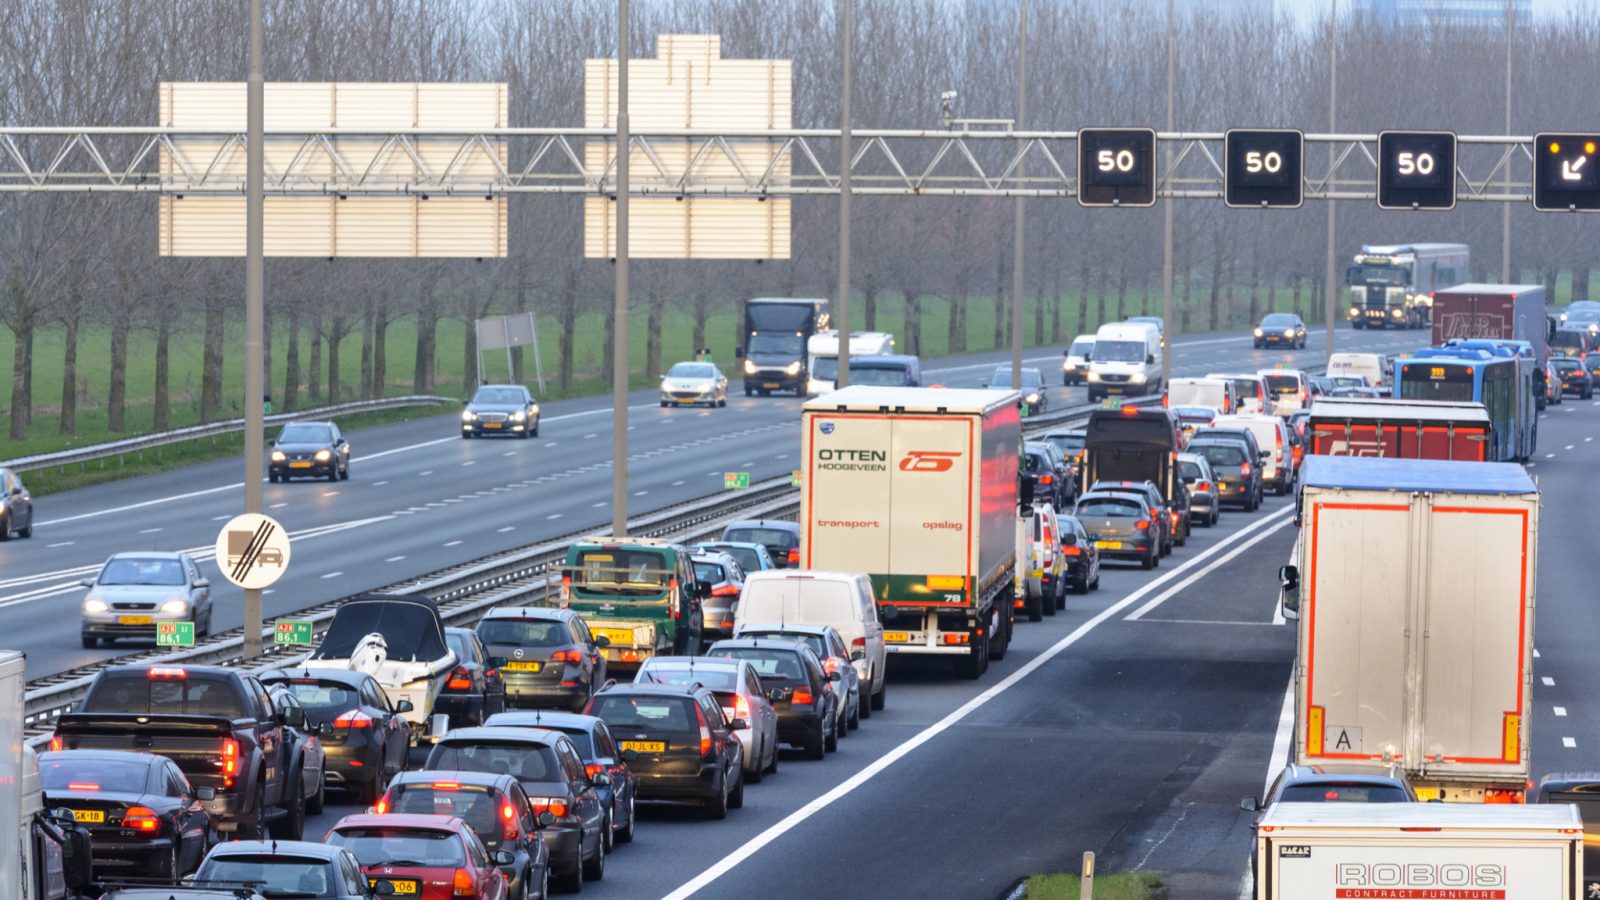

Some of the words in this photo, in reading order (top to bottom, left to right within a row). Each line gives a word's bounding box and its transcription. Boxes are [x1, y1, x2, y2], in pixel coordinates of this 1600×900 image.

[1098, 150, 1134, 171] 50
[1246, 152, 1281, 173] 50
[1398, 152, 1434, 175] 50
[818, 449, 886, 461] OTTEN
[818, 463, 886, 471] HOOGEVEEN
[817, 520, 879, 528] transport
[922, 521, 963, 531] opslag
[944, 594, 961, 602] 78
[160, 625, 175, 633] A28
[1336, 729, 1352, 750] A
[1339, 863, 1502, 886] ROBOS
[1345, 889, 1414, 898] CONTRACT
[1422, 890, 1496, 899] FURNITURE
